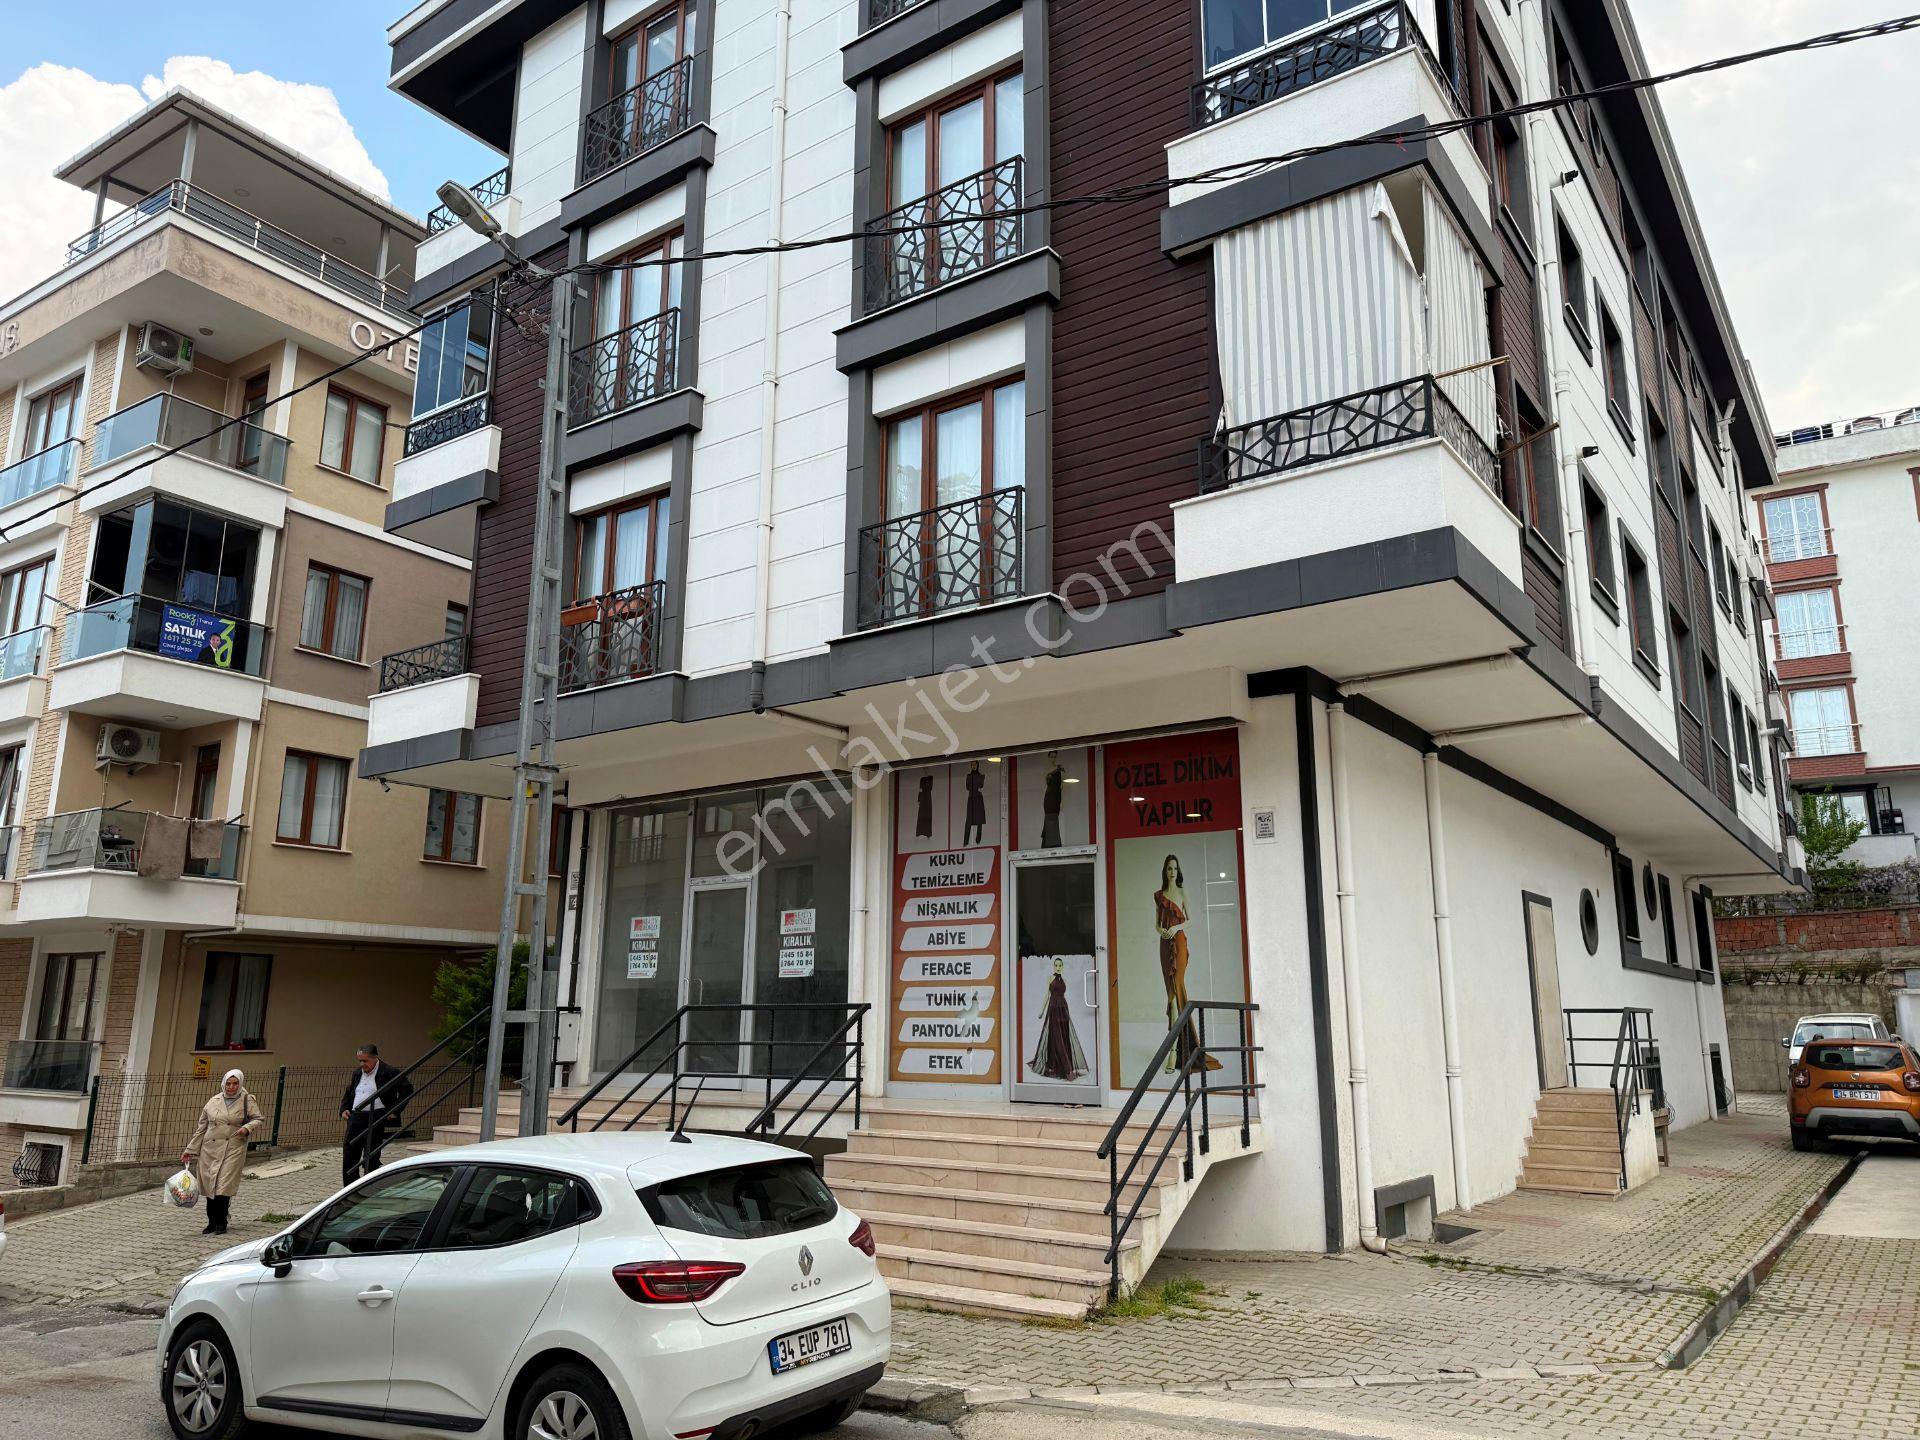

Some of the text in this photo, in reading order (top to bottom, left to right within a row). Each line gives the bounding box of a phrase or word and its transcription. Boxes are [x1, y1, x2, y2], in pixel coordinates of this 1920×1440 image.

[164, 622, 206, 640] SATILIK
[1114, 751, 1233, 789] ÖZEL DİKİM
[1135, 798, 1213, 827] YAPILIR
[929, 853, 965, 867] KURU
[912, 872, 984, 888] TEMİZLEME
[917, 901, 978, 918] NİŞANLIK
[927, 930, 966, 945] ABİYE
[922, 962, 972, 976] FERACE
[926, 989, 967, 1006] TUNİK
[929, 1055, 963, 1069] ETEK
[790, 1277, 821, 1292] CLIO
[778, 1340, 795, 1362] 34
[798, 1331, 819, 1356] EUP
[823, 1324, 845, 1348] 781
